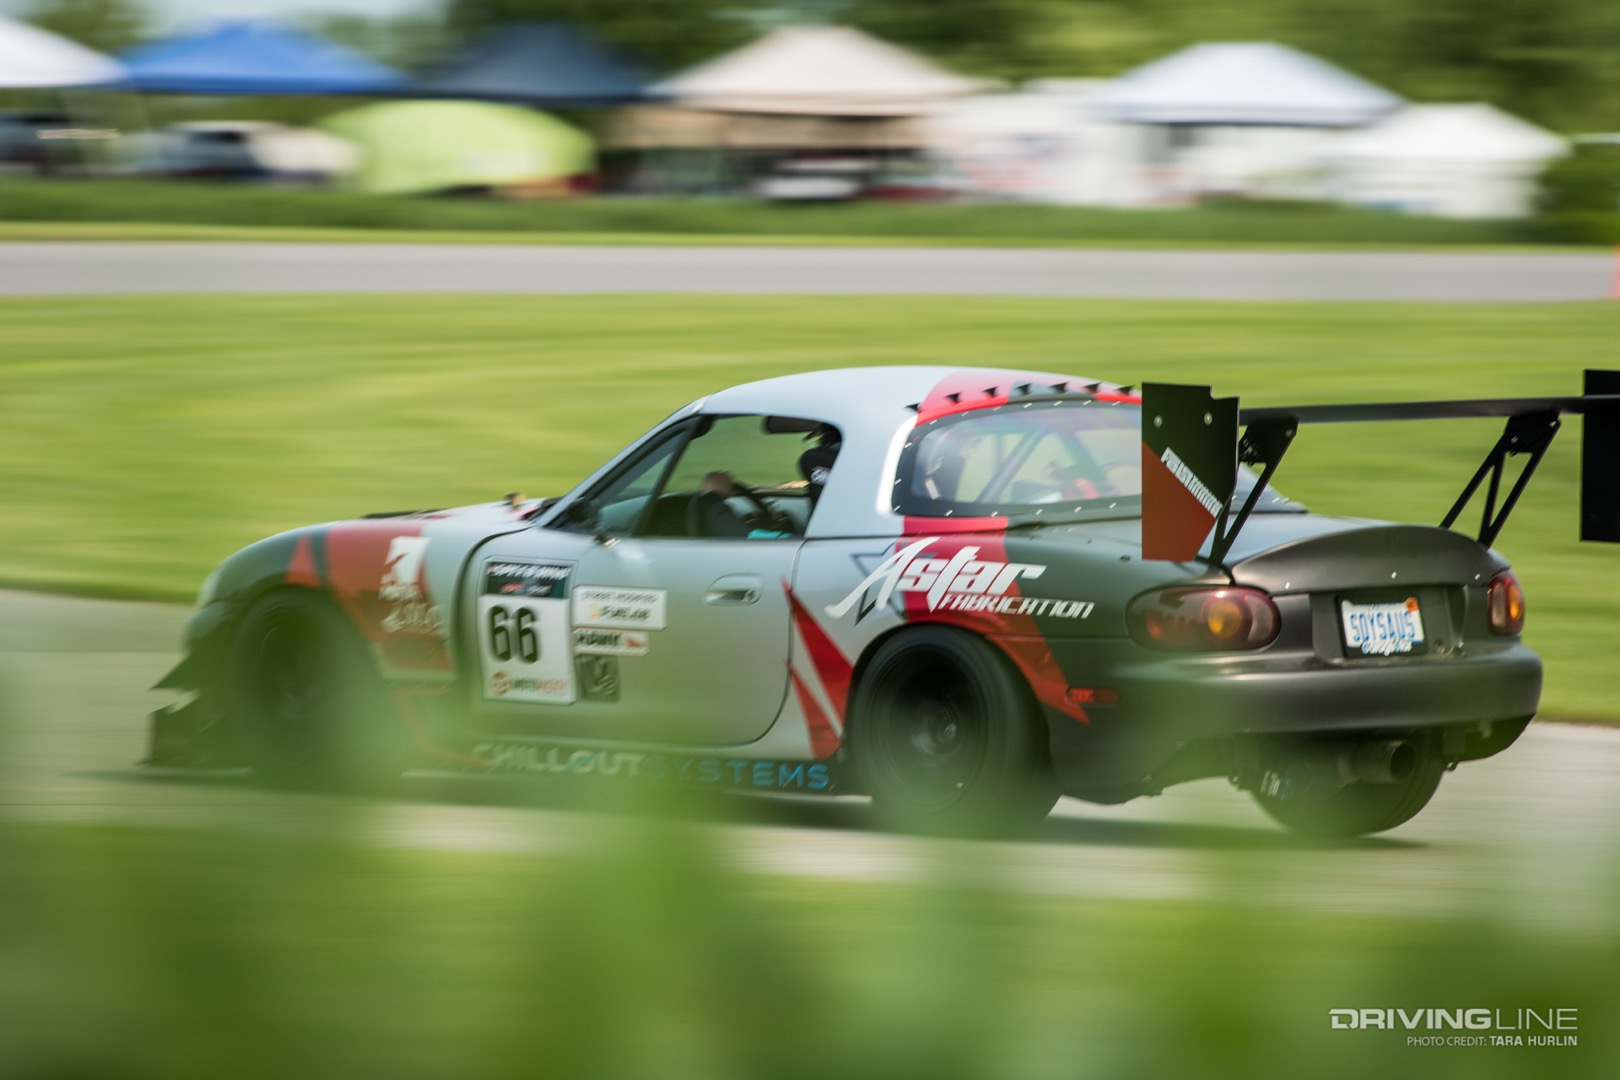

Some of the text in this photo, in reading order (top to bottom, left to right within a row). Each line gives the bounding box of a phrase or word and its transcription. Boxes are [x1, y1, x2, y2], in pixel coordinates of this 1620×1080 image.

[824, 536, 1047, 619] Astar
[938, 594, 1095, 619] FABRICATION
[489, 605, 541, 664] 66
